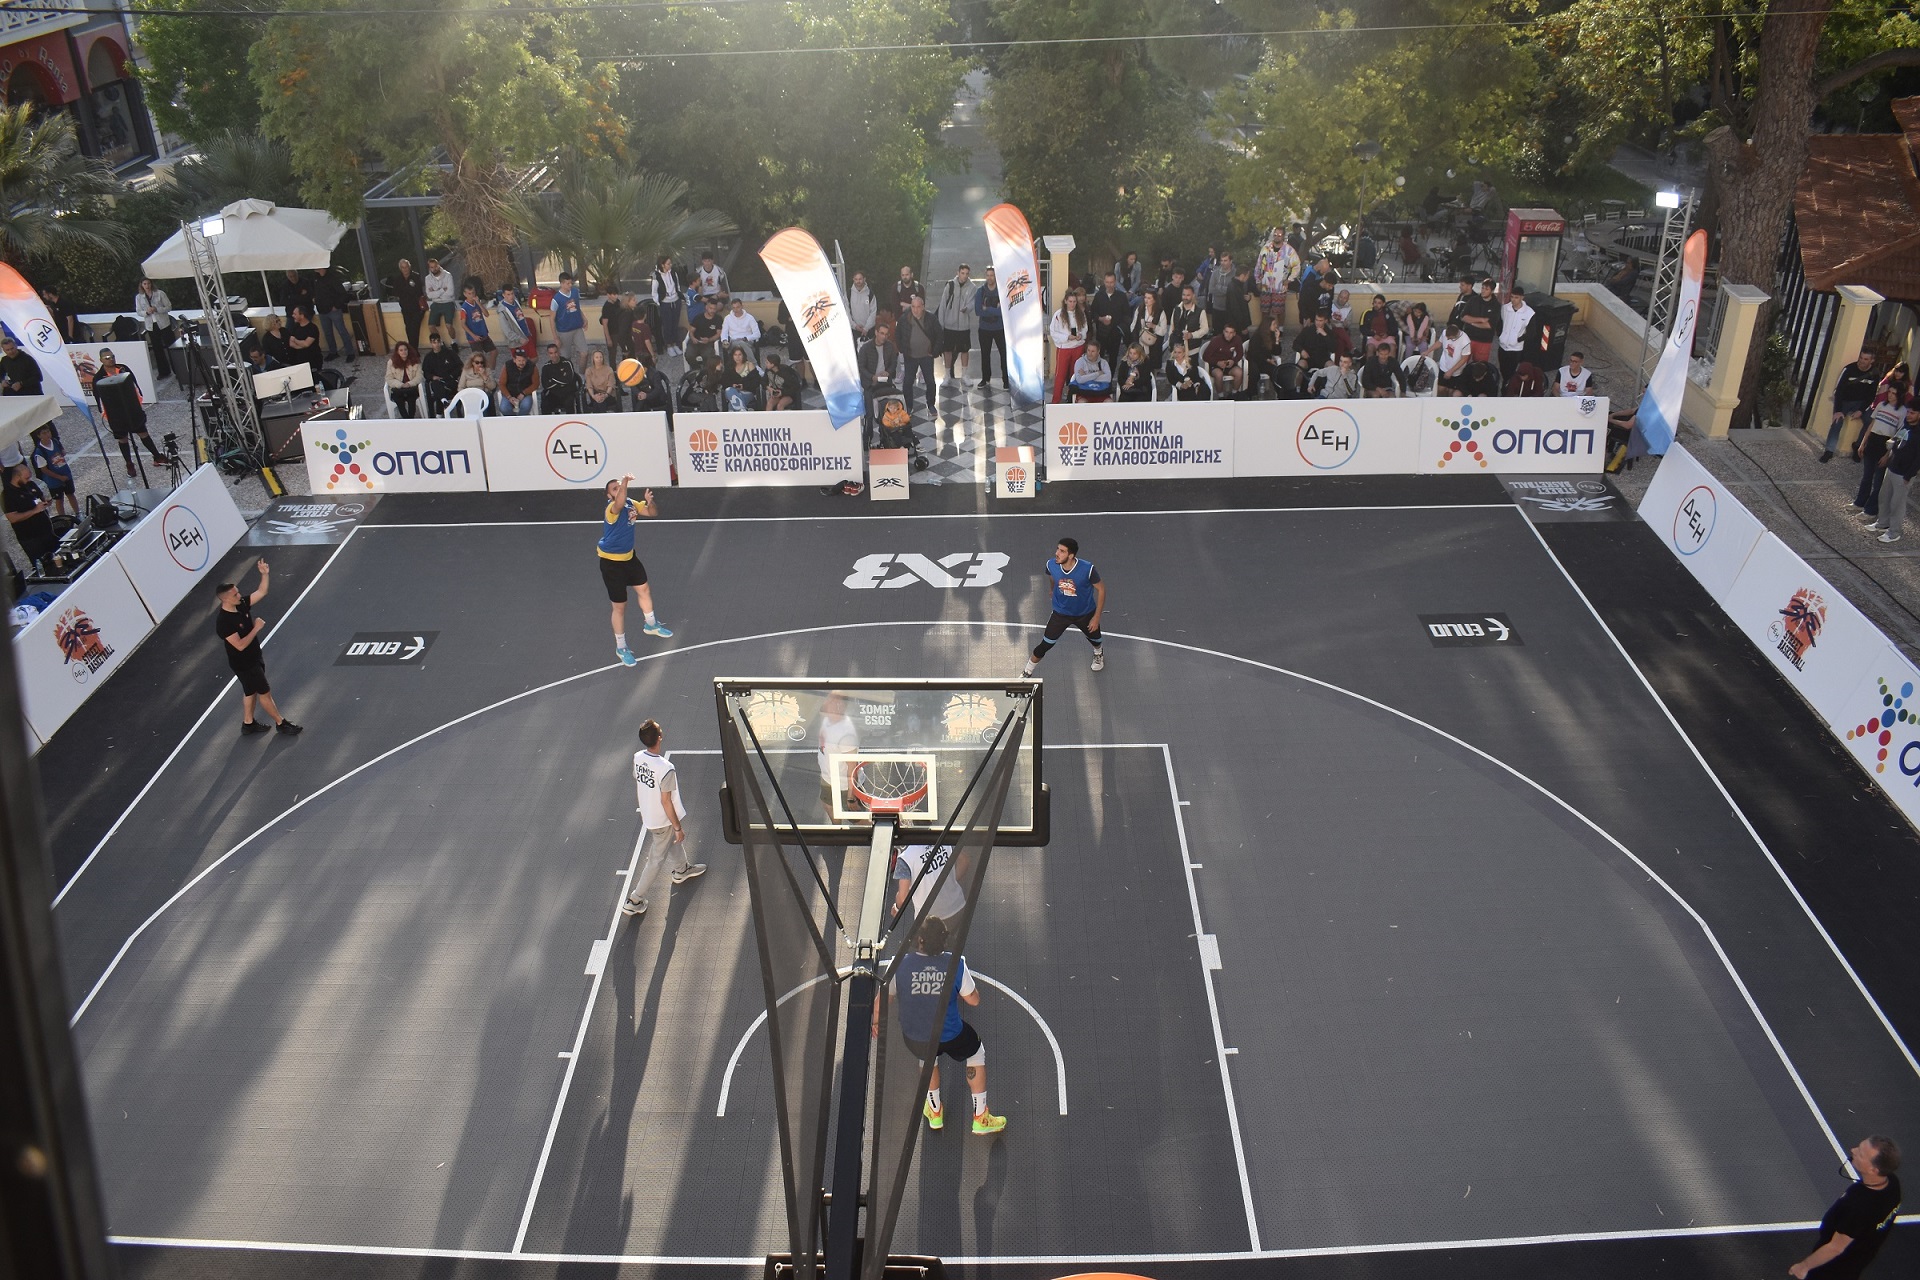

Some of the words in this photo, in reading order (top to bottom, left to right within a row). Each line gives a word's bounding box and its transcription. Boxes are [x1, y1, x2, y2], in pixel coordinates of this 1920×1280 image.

[39, 46, 68, 93] Rania
[722, 427, 791, 442] ΕΛΛΗΝΙΚΗ
[1093, 420, 1163, 435] ΕΛΛΗΝΙΚΗ
[1093, 435, 1184, 450] ΟΜΟΣΠΟΝΔΙΑ
[1303, 424, 1349, 451] ΔΕΗ
[551, 439, 599, 465] ΔΕΗ
[723, 442, 813, 457] ΟΜΟΣΠΟΝΔΙΑ
[1093, 449, 1222, 466] ΚΑΛΑΘΟΣΦΑΙΡΙΣΗΣ
[724, 456, 852, 473] ΚΑΛΑΘΟΣΦΑΙΡΙΣΗΣ
[1538, 487, 1577, 495] STREET
[290, 510, 331, 518] STREET
[1683, 498, 1706, 543] ΔΕΗ
[169, 527, 203, 551] ΔΕΗ
[1428, 623, 1486, 637] ENLIO
[1770, 623, 1780, 639] ΔΕΗ
[346, 641, 402, 656] ENLIO
[1782, 630, 1804, 654] STREET
[82, 642, 101, 666] STREET
[87, 643, 115, 675] BASKETBALL
[1776, 639, 1806, 673] BASKETBALL
[74, 668, 87, 679] ΔΕΗ
[911, 982, 944, 995] 202
